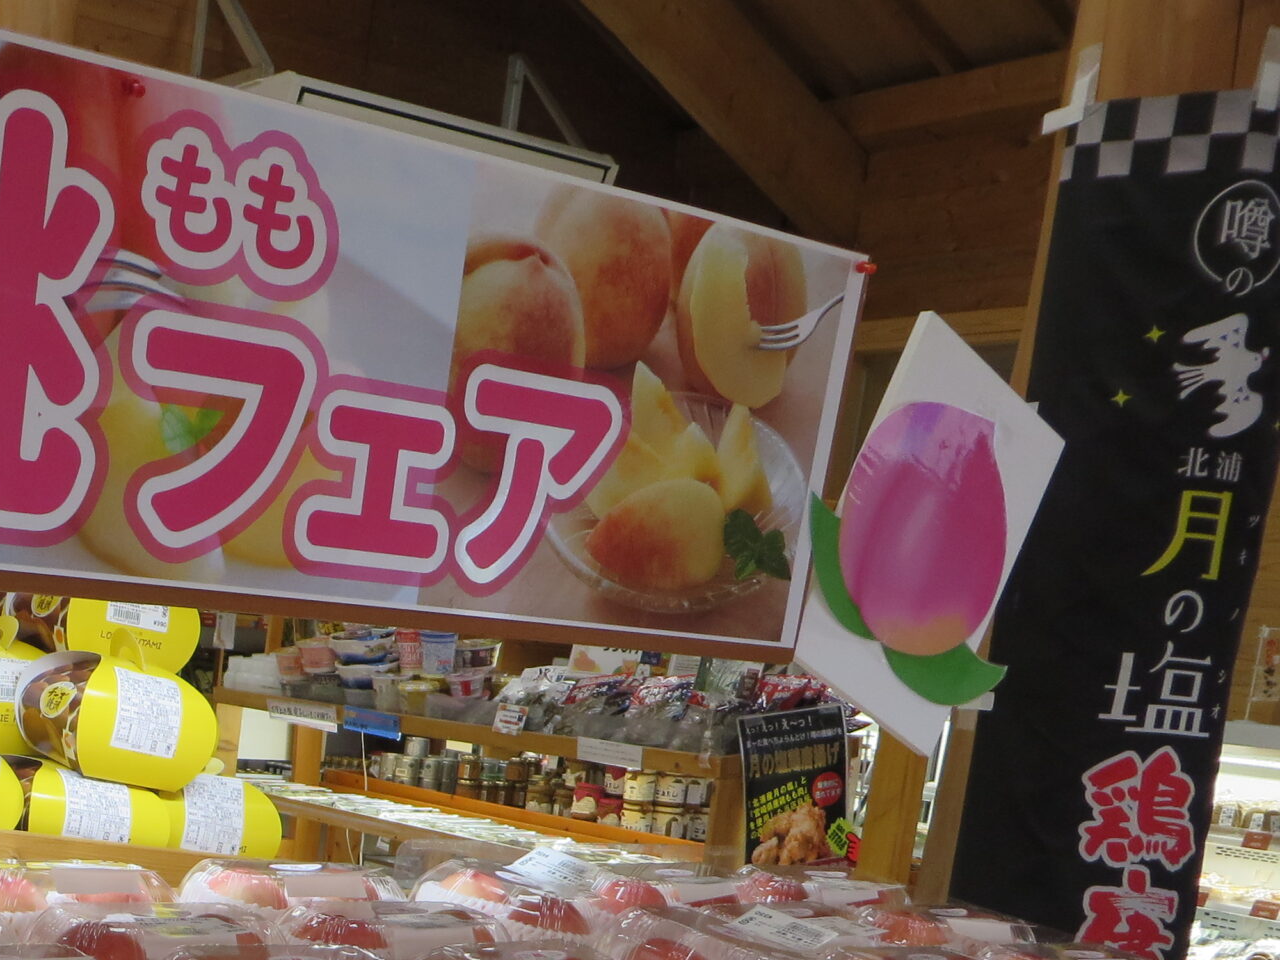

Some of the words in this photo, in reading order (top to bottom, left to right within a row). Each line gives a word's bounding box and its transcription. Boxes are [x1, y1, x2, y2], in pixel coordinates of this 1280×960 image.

[141, 118, 329, 288] もも
[1219, 197, 1276, 297] 噂の
[131, 309, 623, 583] フェア
[1177, 446, 1244, 484] 北浦
